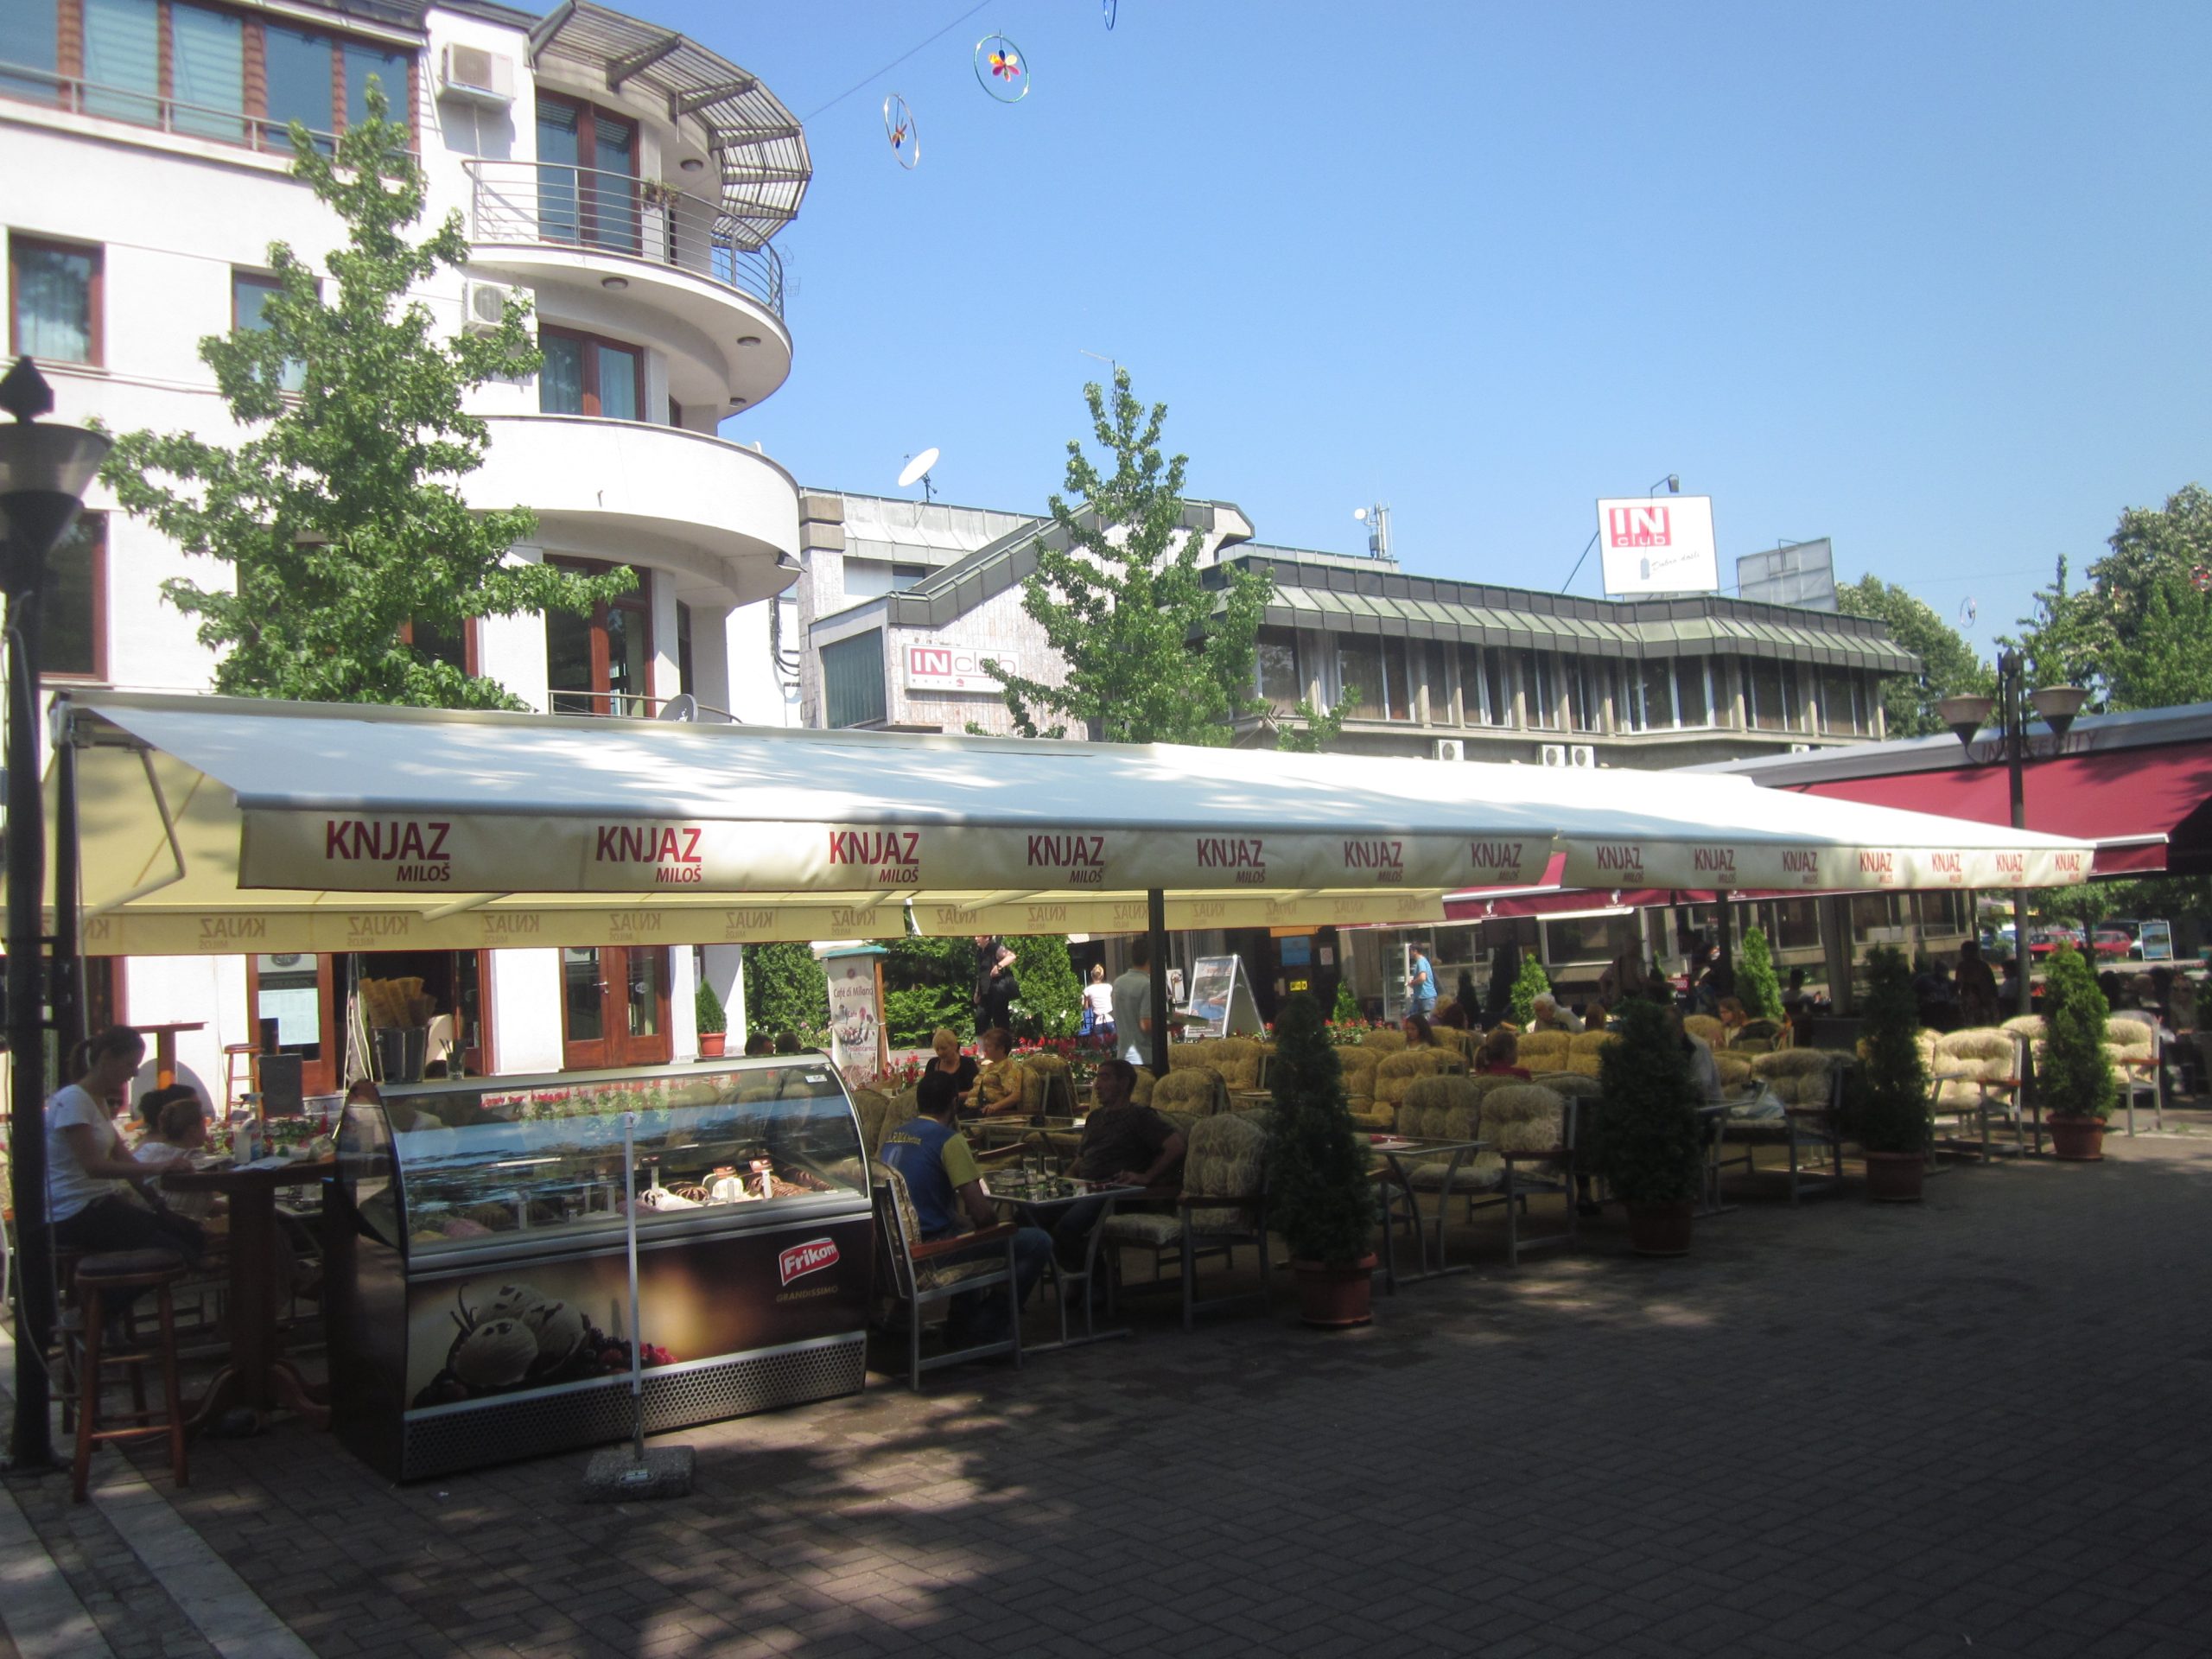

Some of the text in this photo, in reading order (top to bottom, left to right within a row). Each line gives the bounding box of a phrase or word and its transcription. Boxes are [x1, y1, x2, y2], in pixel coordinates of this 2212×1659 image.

[1615, 508, 1665, 534] IN
[1618, 533, 1666, 546] club
[913, 651, 949, 673] IN
[326, 820, 450, 861] KNJAZ
[595, 826, 702, 862] KNJAZ
[830, 831, 919, 865] KNJAZ
[1027, 835, 1104, 866] KNJAZ
[1197, 838, 1265, 868] KNJAZ
[1344, 841, 1403, 868] KNJAZ
[1471, 842, 1522, 868] KNJAZ
[1597, 846, 1643, 870] KNJAZ
[1694, 849, 1735, 870] KNJAZ
[1783, 851, 1818, 871] KNJAZ
[1860, 852, 1892, 871] KNJAZ
[1932, 853, 1961, 872] KNJAZ
[1996, 854, 2023, 872] KNJAZ
[2055, 854, 2080, 872] KNJAZ
[397, 862, 450, 882] MILOŠ
[656, 864, 702, 883] MILOŠ
[879, 866, 918, 883] MILOŠ
[1069, 868, 1103, 883] MILOŠ
[1236, 868, 1265, 884] MILOŠ
[784, 1244, 837, 1274] Frikom
[776, 1286, 838, 1302] GRANDISSIMO
